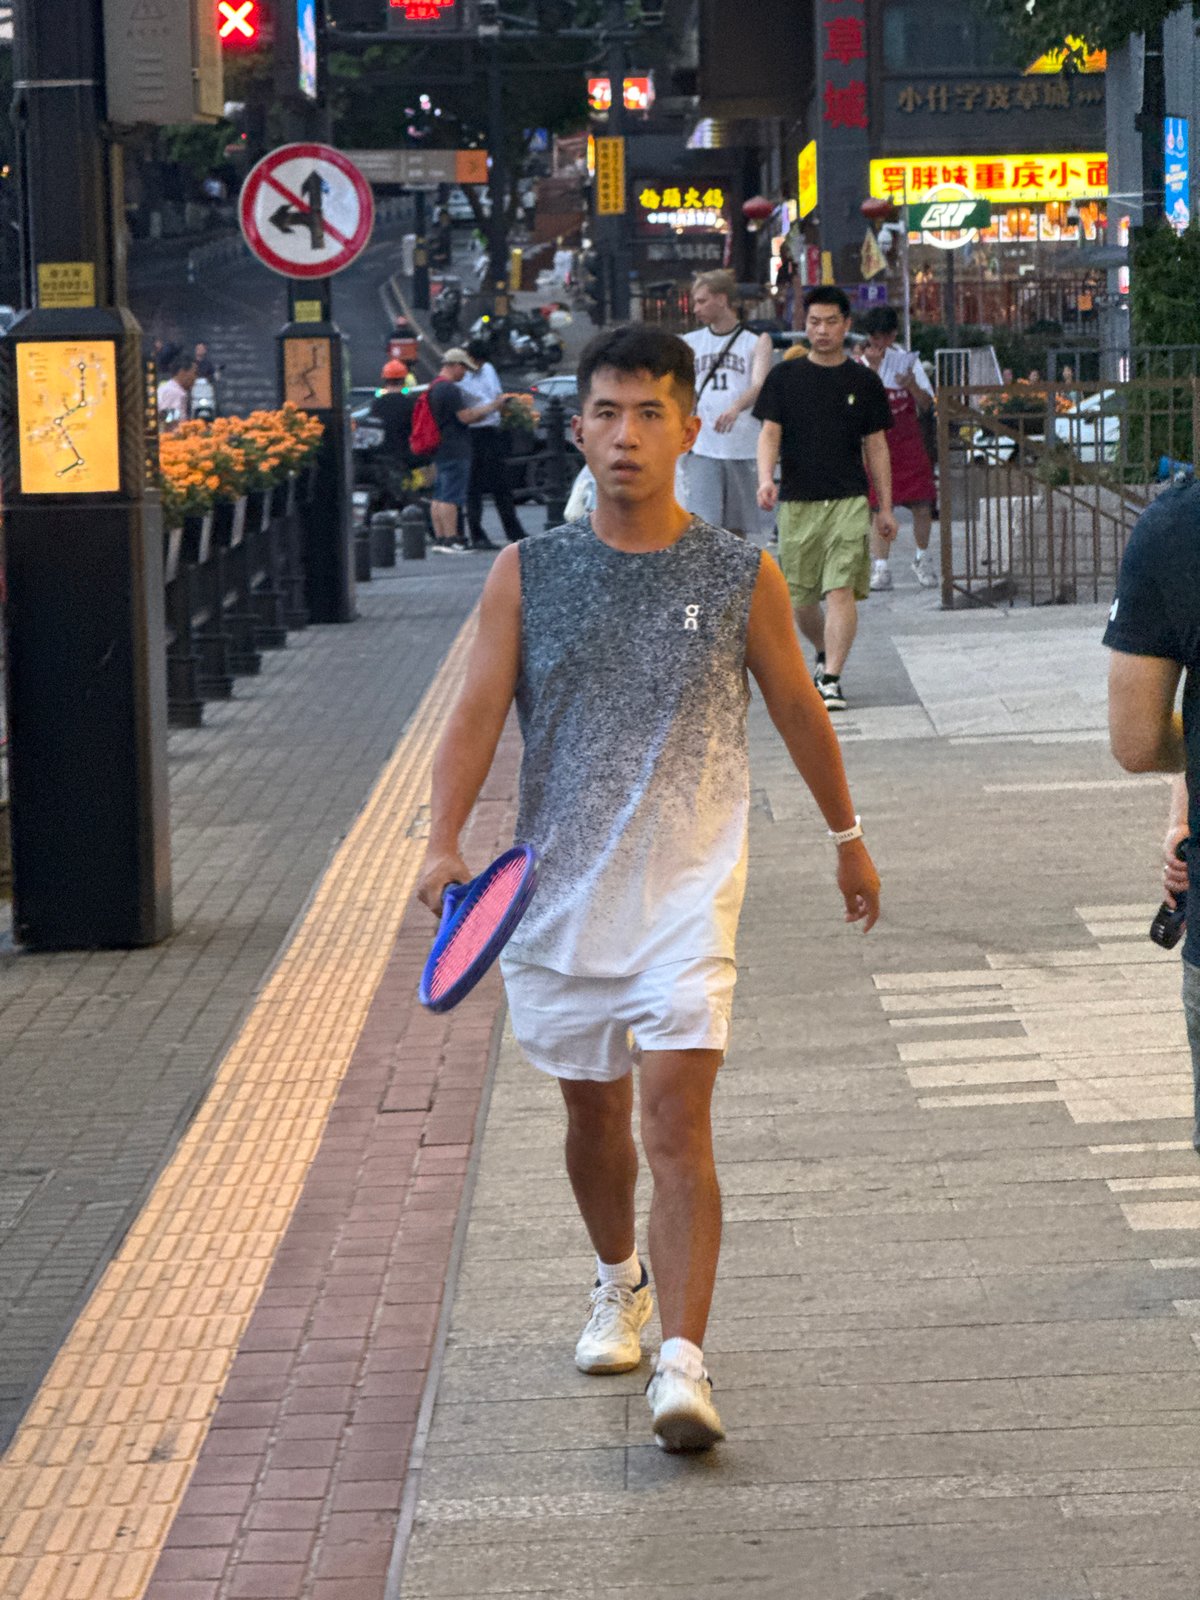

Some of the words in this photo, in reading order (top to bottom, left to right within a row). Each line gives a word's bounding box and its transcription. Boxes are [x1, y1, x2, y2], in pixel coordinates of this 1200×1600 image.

[882, 160, 1108, 192] 罗胖妹重庆小面
[712, 373, 728, 390] 11
